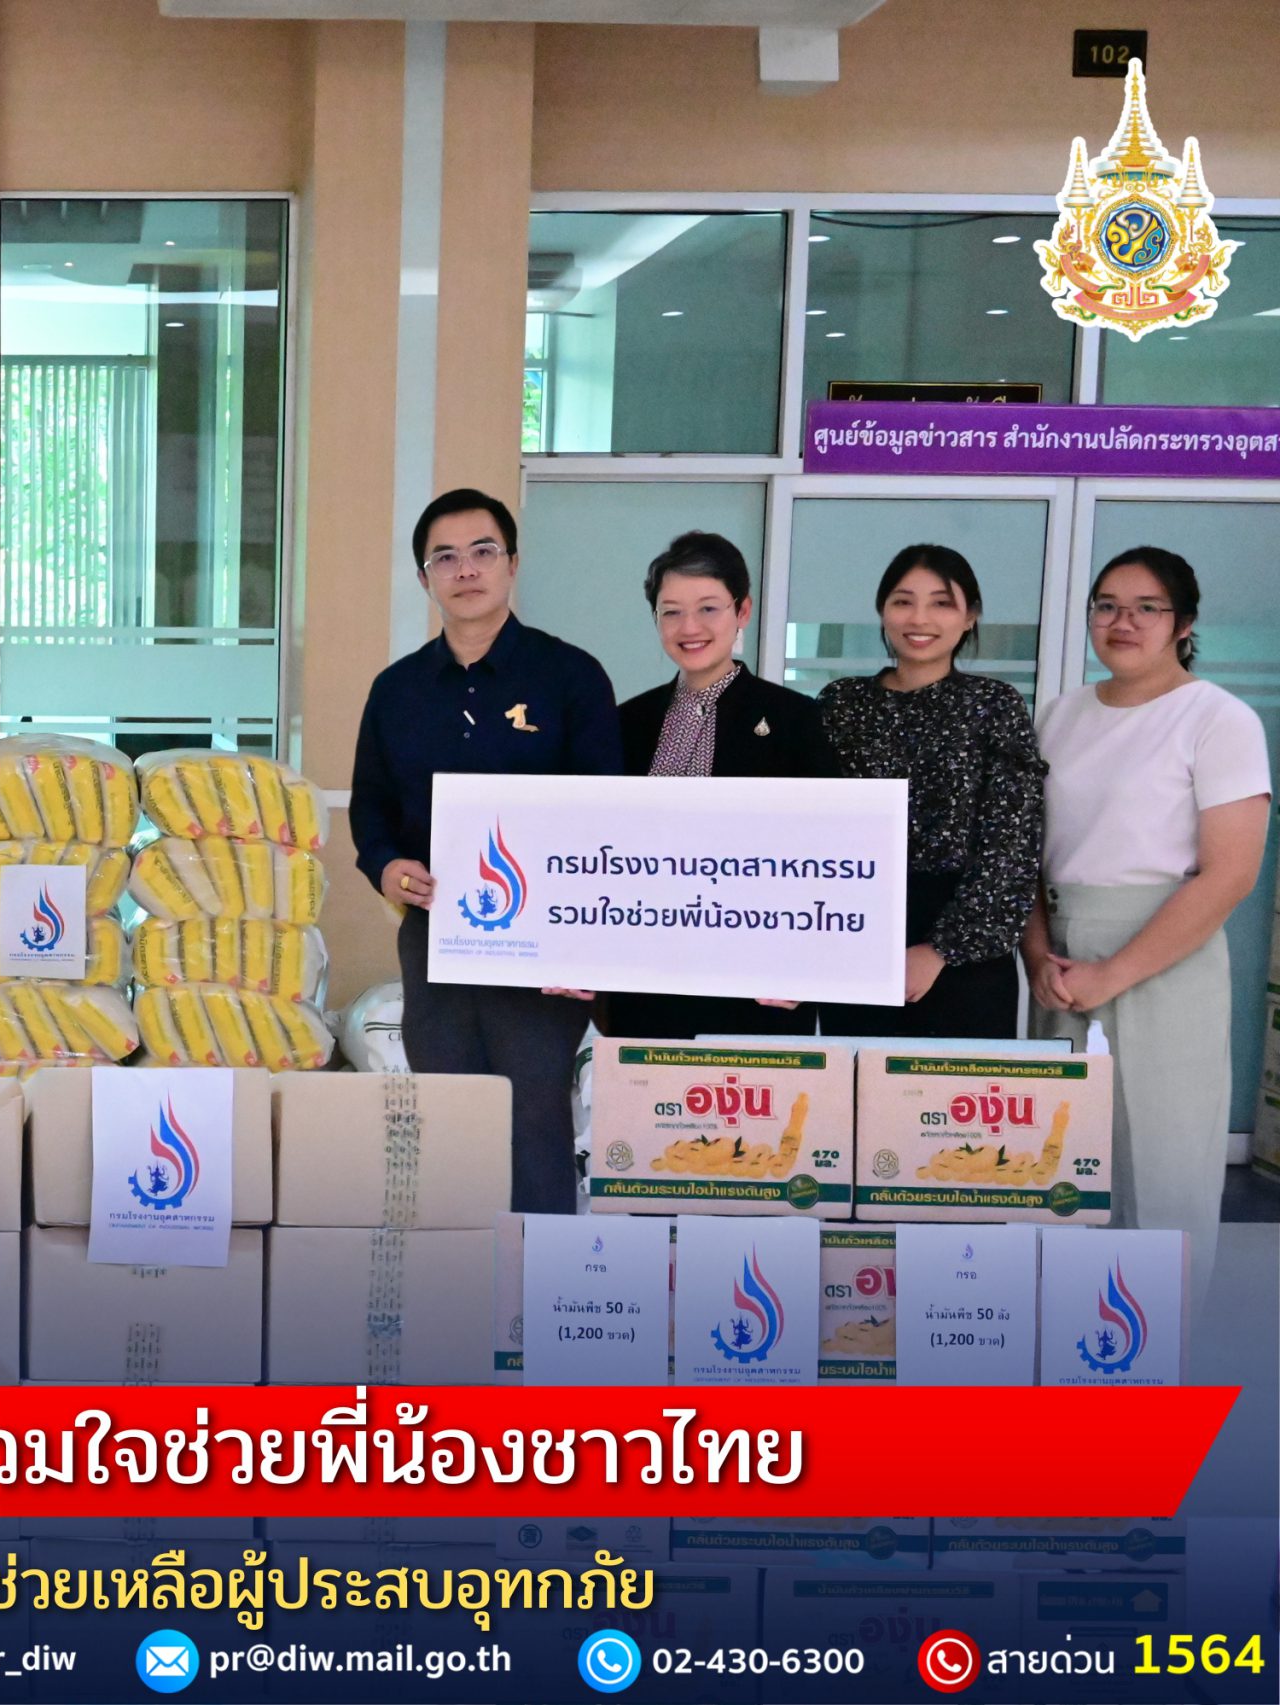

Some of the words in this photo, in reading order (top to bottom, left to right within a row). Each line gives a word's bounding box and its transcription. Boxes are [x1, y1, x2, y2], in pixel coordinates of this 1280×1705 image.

[1089, 44, 1129, 64] 102
[814, 420, 998, 455] ศูนย์ข้อมูลข่าวสาร
[1003, 424, 1280, 460] สำนักงานปลัดกระทรวงอุตส
[547, 845, 876, 885] กรมโรงงานอุตสาหกรรม
[548, 894, 866, 933] รวมใจช่วยพี่น้องชาวไทย
[655, 1102, 682, 1116] ตรา
[685, 1075, 773, 1127] องุ่น
[920, 1111, 947, 1126] ตรา
[950, 1085, 1035, 1134] องุ่น
[812, 1150, 840, 1159] 470
[1073, 1158, 1100, 1167] 470
[585, 1264, 607, 1273] กรอ
[956, 1271, 977, 1280] กรอ
[825, 1285, 852, 1298] ตรา
[553, 1296, 602, 1313] น้ำมันพืช
[606, 1302, 623, 1314] 50
[627, 1302, 641, 1314] ลัง
[925, 1303, 973, 1320] น้ำมันพืช
[977, 1308, 994, 1320] 50
[998, 1308, 1010, 1320] ลัง
[558, 1325, 604, 1341] (1,200
[607, 1327, 635, 1343] ขวด)
[930, 1332, 975, 1347] (1,200
[978, 1333, 1005, 1349] ขวด)
